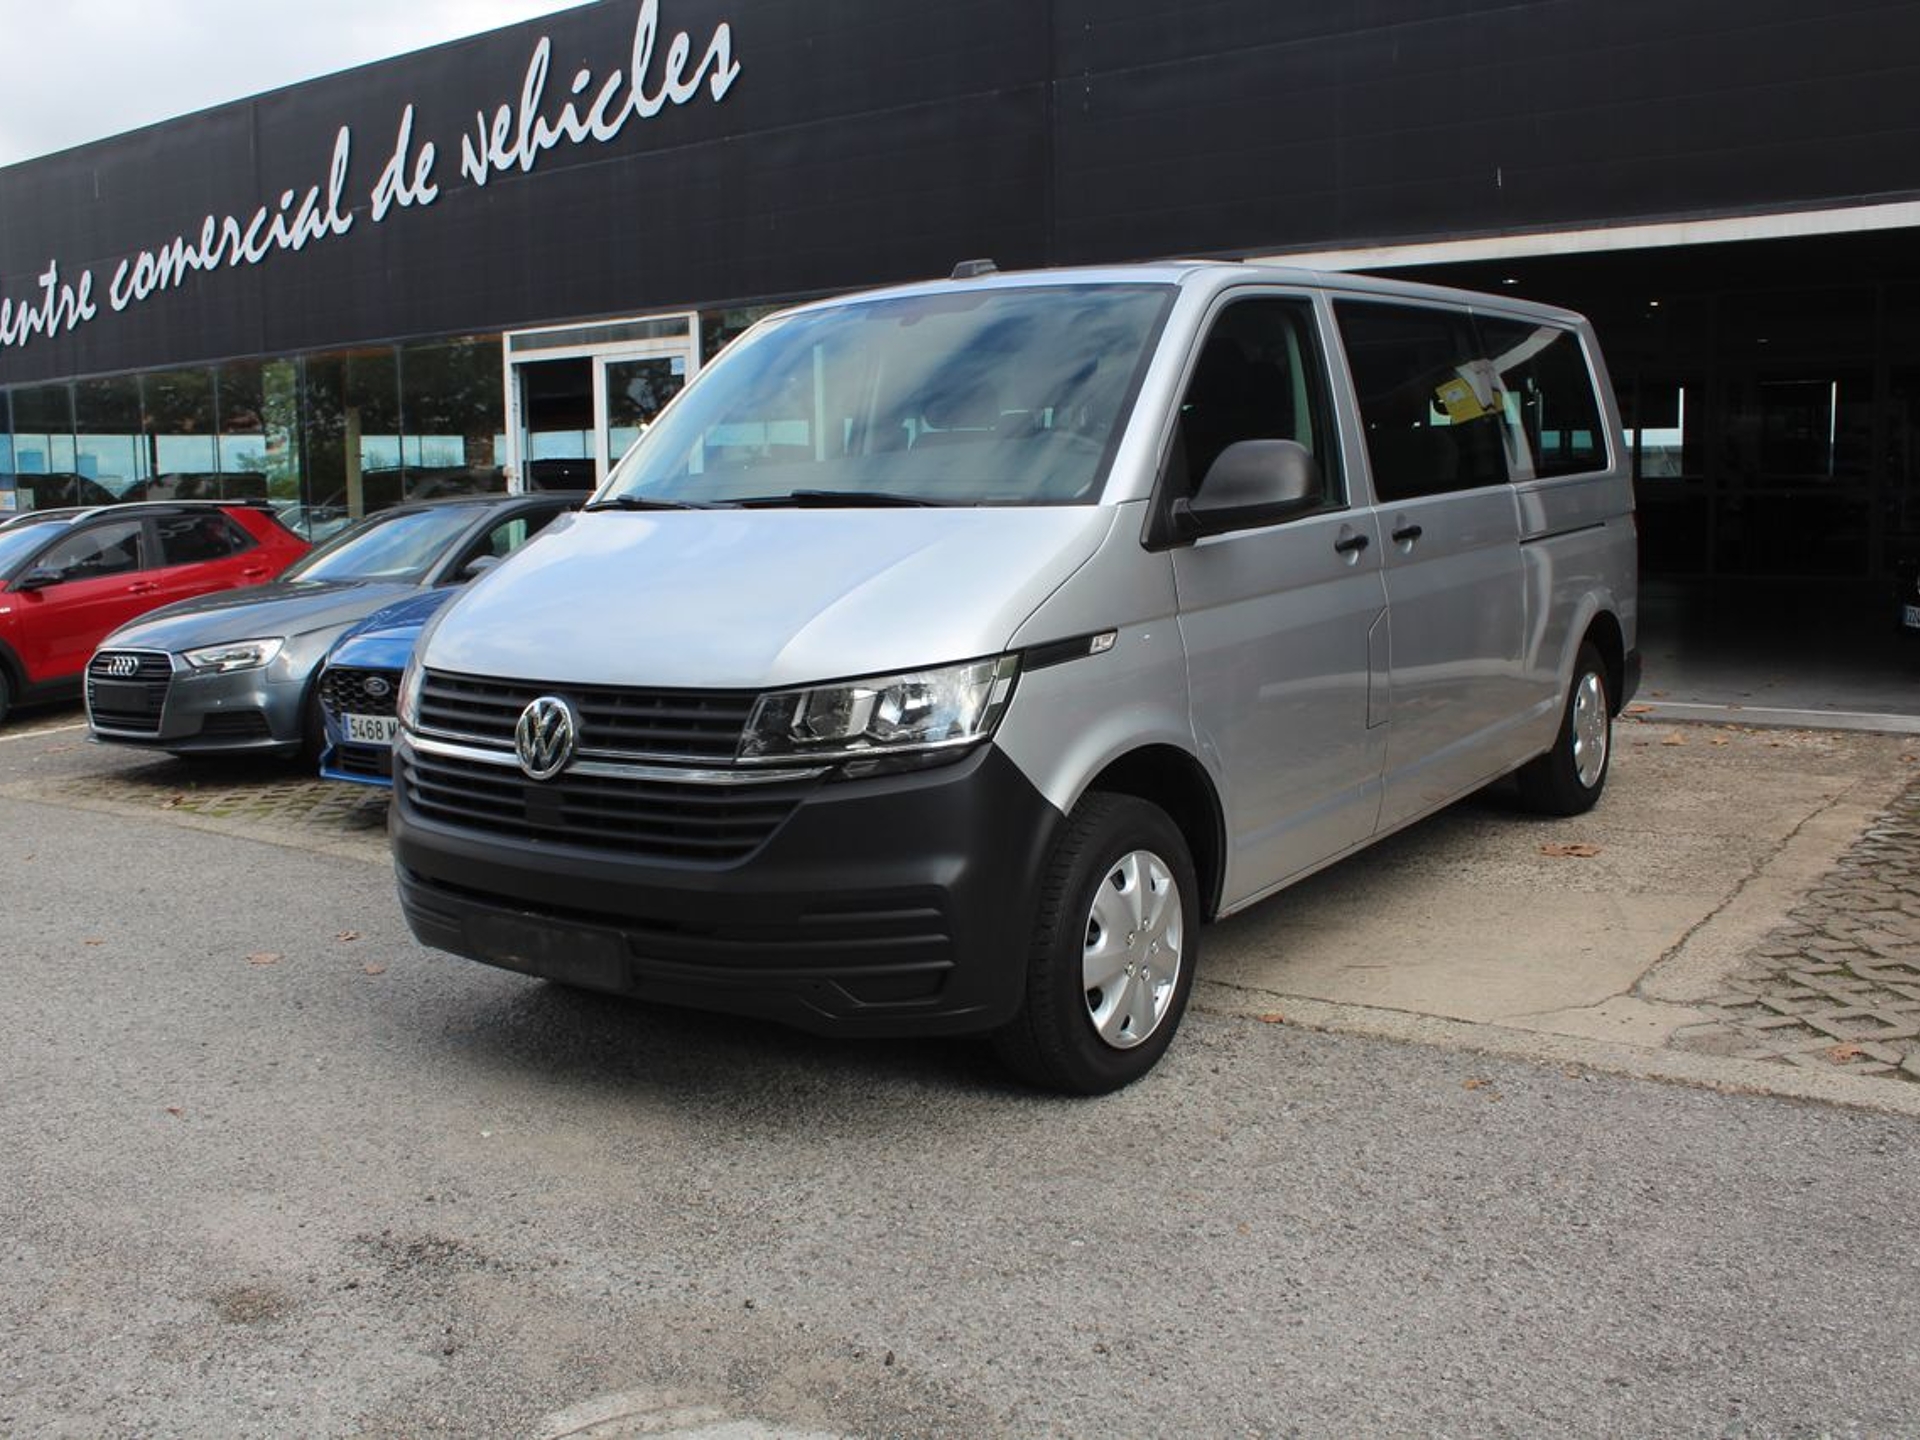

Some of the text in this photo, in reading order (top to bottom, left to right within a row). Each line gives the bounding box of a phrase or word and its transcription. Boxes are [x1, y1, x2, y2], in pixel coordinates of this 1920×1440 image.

[109, 125, 353, 311] comercial
[371, 103, 438, 222] de
[461, 0, 741, 187] vehicles
[350, 717, 384, 741] 5468
